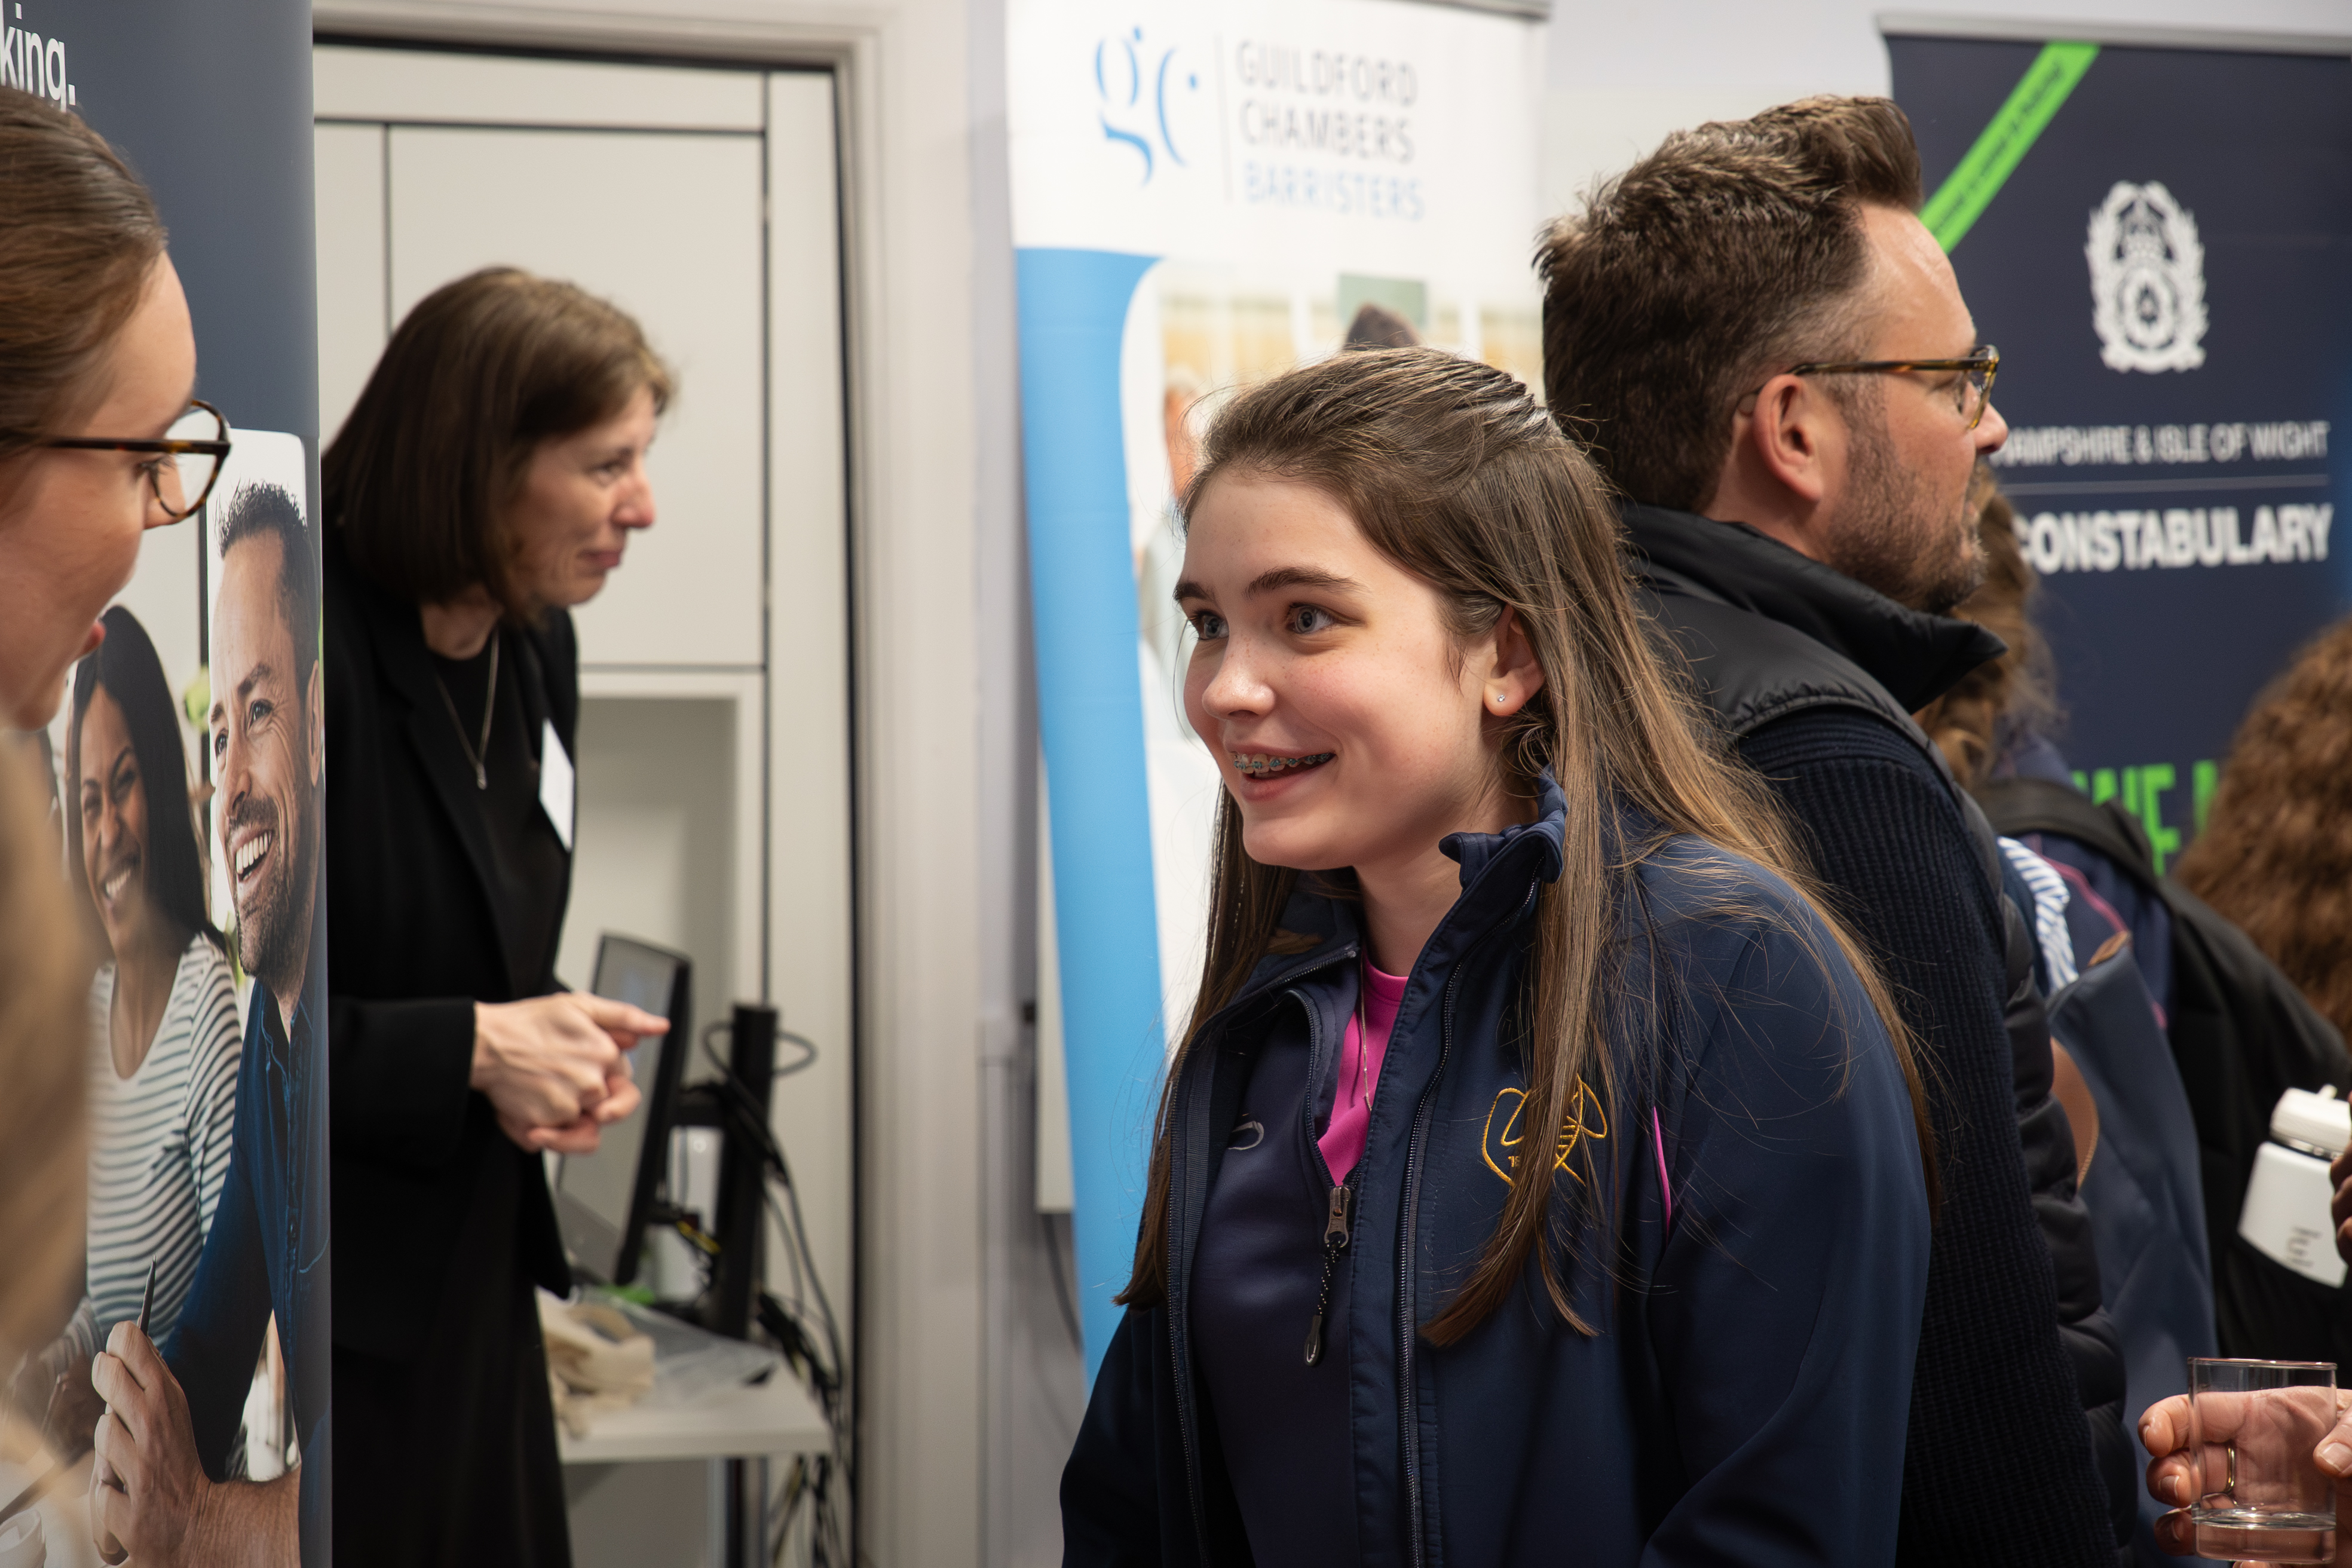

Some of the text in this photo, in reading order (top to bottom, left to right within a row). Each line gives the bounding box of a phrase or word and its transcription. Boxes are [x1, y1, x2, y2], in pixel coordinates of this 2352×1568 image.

[1235, 39, 1419, 108] GUILDFORD
[1239, 98, 1416, 165] CHAMBERS
[1244, 160, 1426, 222] BARRISTERS
[2133, 424, 2152, 465] &
[2153, 423, 2210, 464] ISLE
[2210, 422, 2246, 463] OF
[2246, 419, 2330, 461] WIGHT
